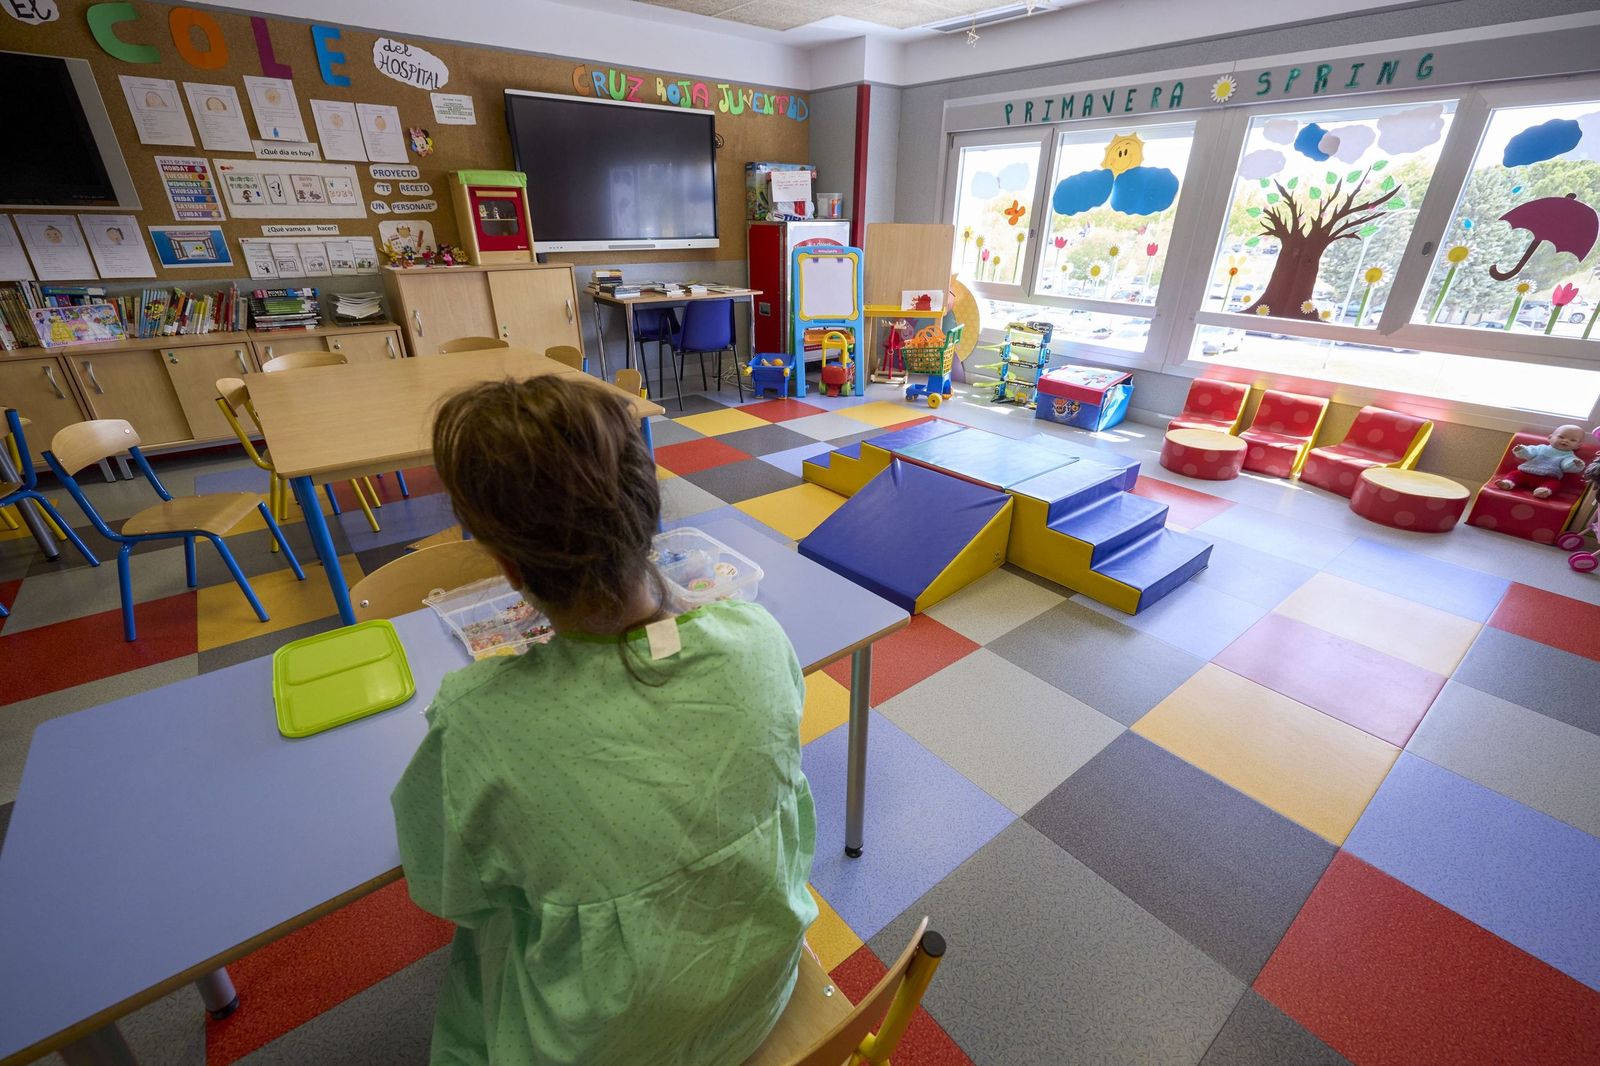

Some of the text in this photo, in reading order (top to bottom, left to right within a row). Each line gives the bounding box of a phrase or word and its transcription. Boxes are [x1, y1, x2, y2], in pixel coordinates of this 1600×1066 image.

[87, 1, 351, 88] COLE
[382, 39, 412, 57] del
[379, 51, 440, 90] HOSPITAL
[572, 65, 809, 122] CRUZ ROJA JUVENTUD
[1004, 52, 1433, 125] PRIMAVERA SPRING
[298, 149, 314, 157] hoy?
[372, 169, 418, 178] PROYECTO
[400, 184, 430, 192] RECETO
[372, 202, 385, 210] UN
